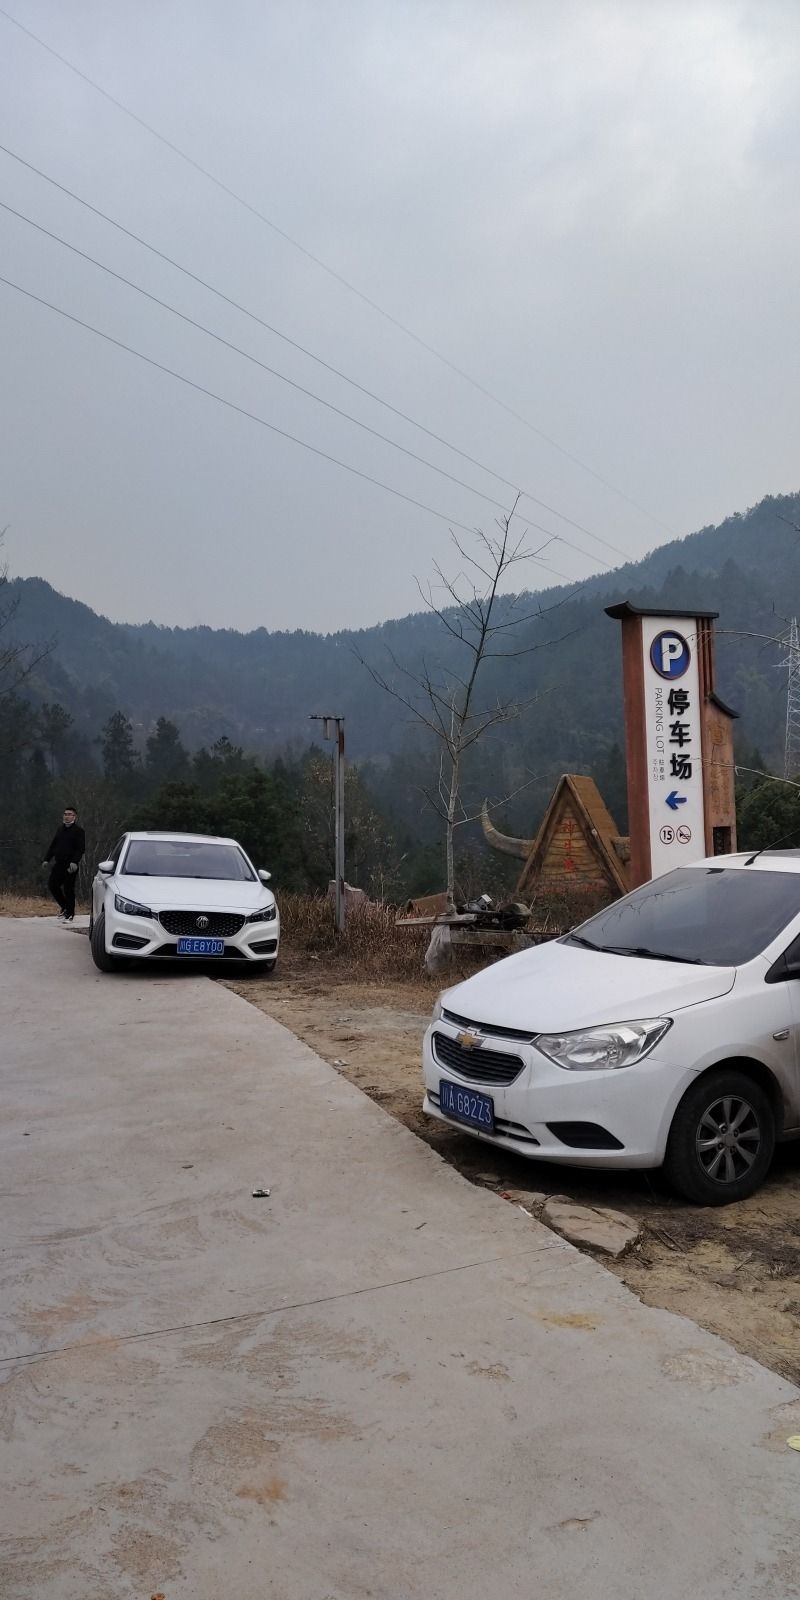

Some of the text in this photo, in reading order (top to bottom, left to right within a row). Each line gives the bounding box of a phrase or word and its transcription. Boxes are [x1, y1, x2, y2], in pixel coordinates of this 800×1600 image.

[661, 637, 684, 672] P
[655, 687, 665, 754] PARKING LOT
[667, 688, 692, 780] 停车场
[662, 830, 673, 841] 15
